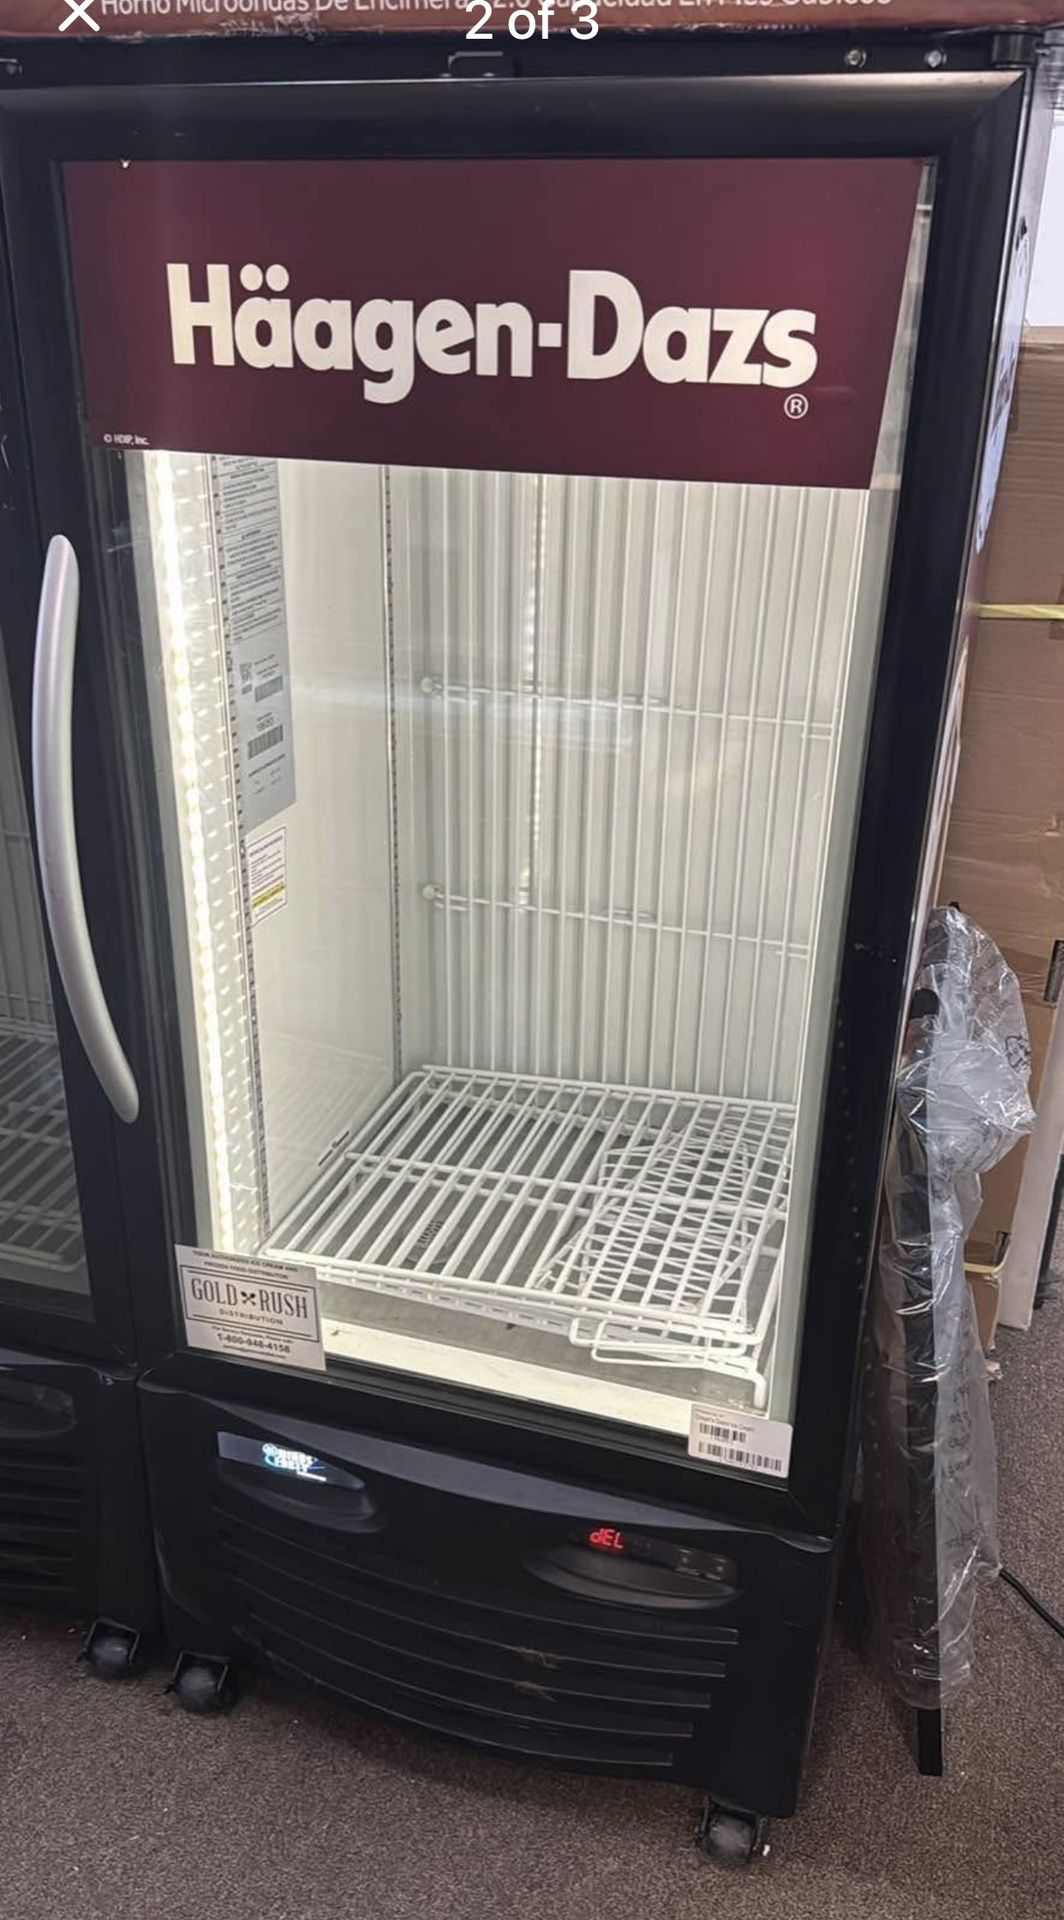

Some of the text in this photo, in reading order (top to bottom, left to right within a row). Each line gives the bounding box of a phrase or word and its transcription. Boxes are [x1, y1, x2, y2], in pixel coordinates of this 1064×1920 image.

[166, 262, 818, 404] Häagen-Dazs
[191, 1277, 308, 1319] GOLD RUSH
[219, 1308, 284, 1326] DISTRIBUTION
